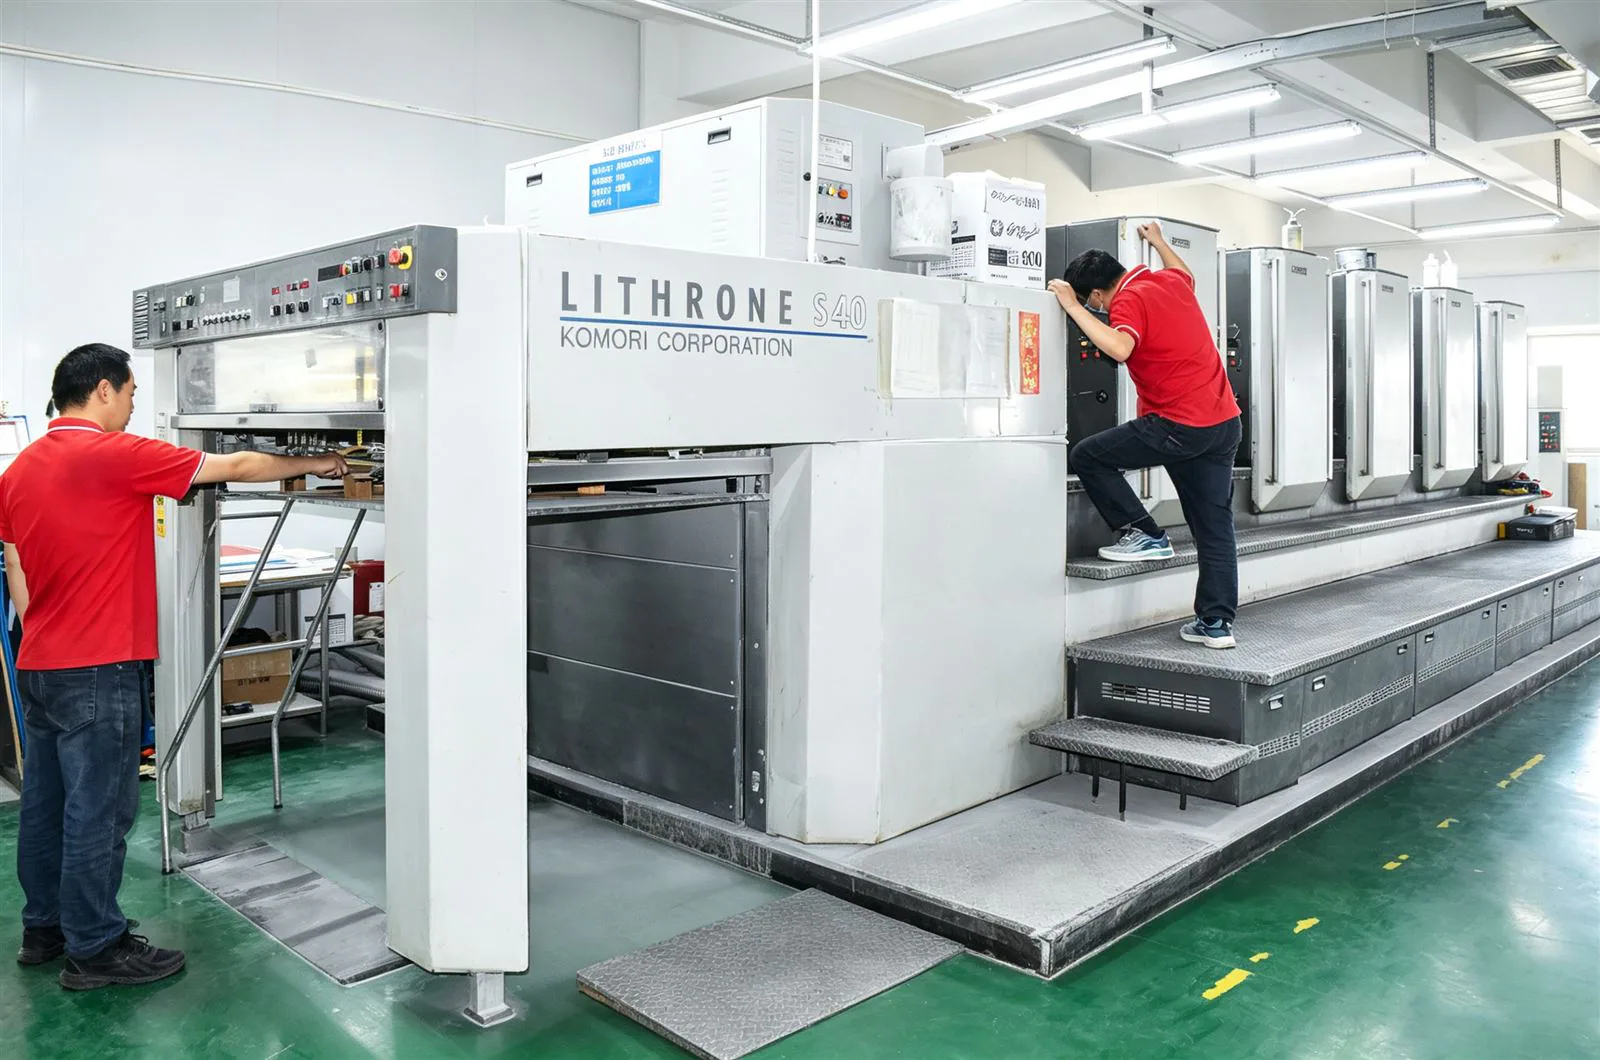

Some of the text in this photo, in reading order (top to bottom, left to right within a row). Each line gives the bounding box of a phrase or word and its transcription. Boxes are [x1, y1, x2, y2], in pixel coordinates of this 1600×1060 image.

[561, 271, 867, 331] LITHRONE S40
[560, 325, 793, 358] KOMORI CORPORATION
